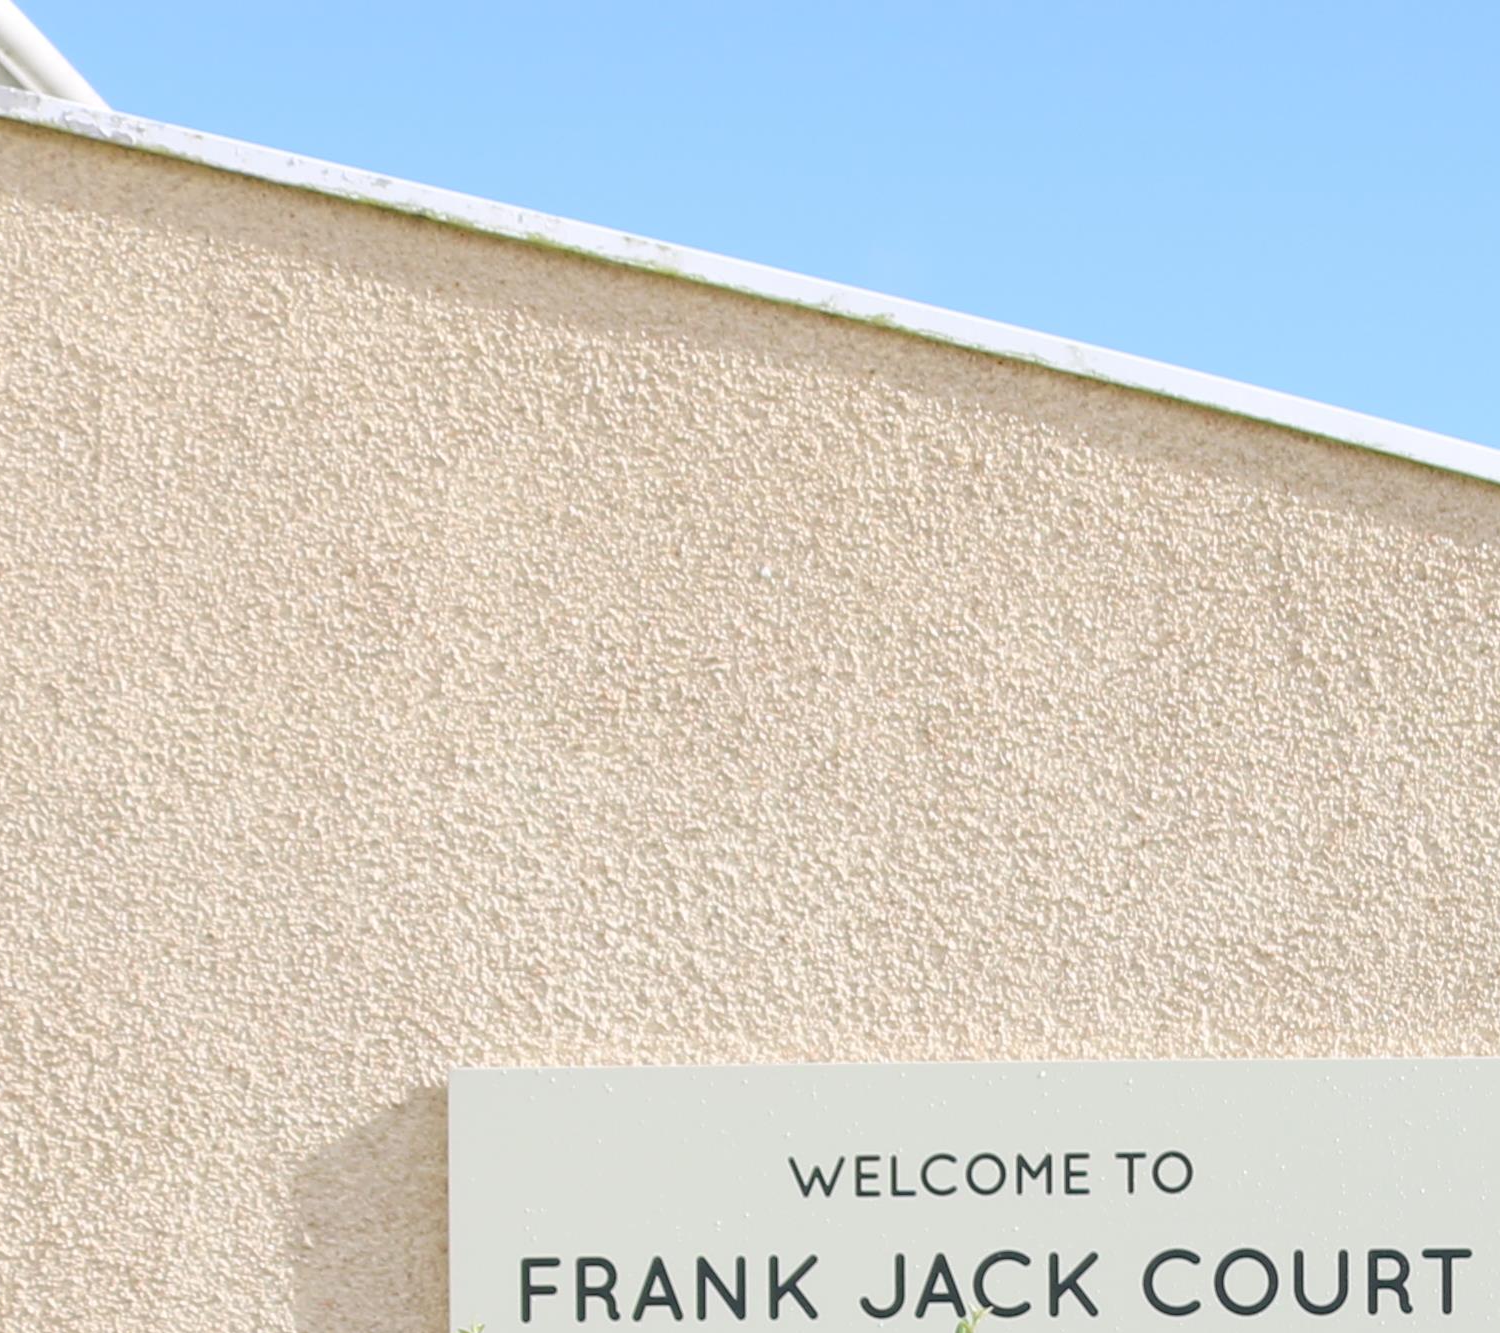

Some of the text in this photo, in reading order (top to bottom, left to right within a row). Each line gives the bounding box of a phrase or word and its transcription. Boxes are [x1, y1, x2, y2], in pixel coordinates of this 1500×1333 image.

[788, 1150, 1193, 1198] WELCOME TO
[520, 1247, 1473, 1323] FRANK JACK COURT
